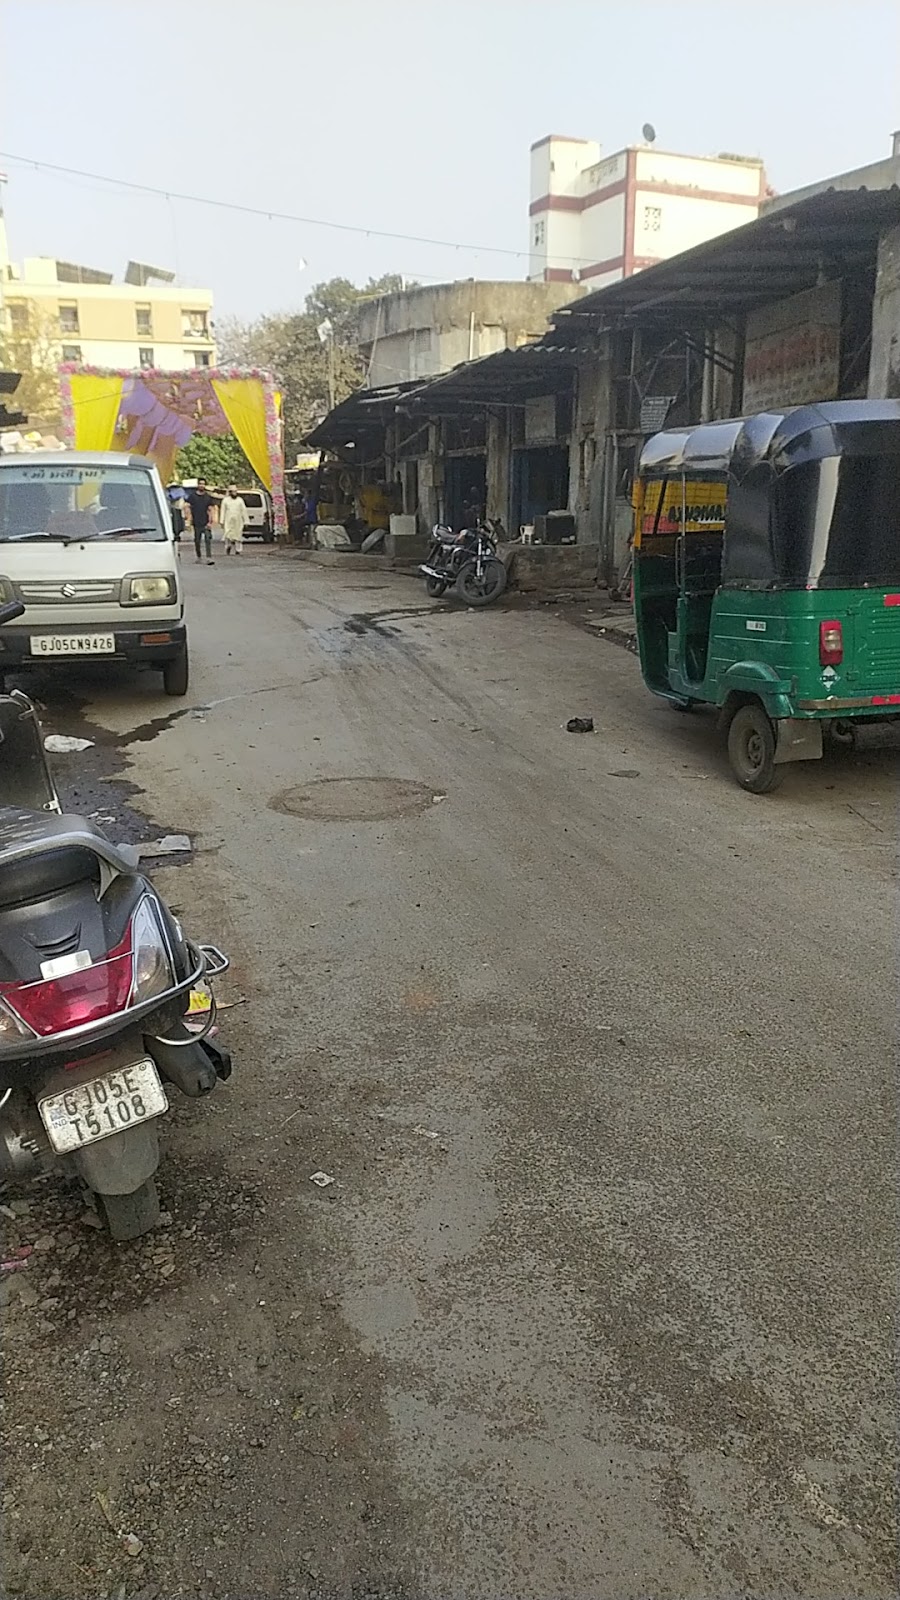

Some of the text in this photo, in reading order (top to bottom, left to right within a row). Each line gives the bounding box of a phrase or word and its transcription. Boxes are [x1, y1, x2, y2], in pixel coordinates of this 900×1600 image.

[40, 637, 113, 652] GJ05CN9426
[63, 1069, 139, 1116] GJ05E
[70, 1094, 146, 1142] T5108
